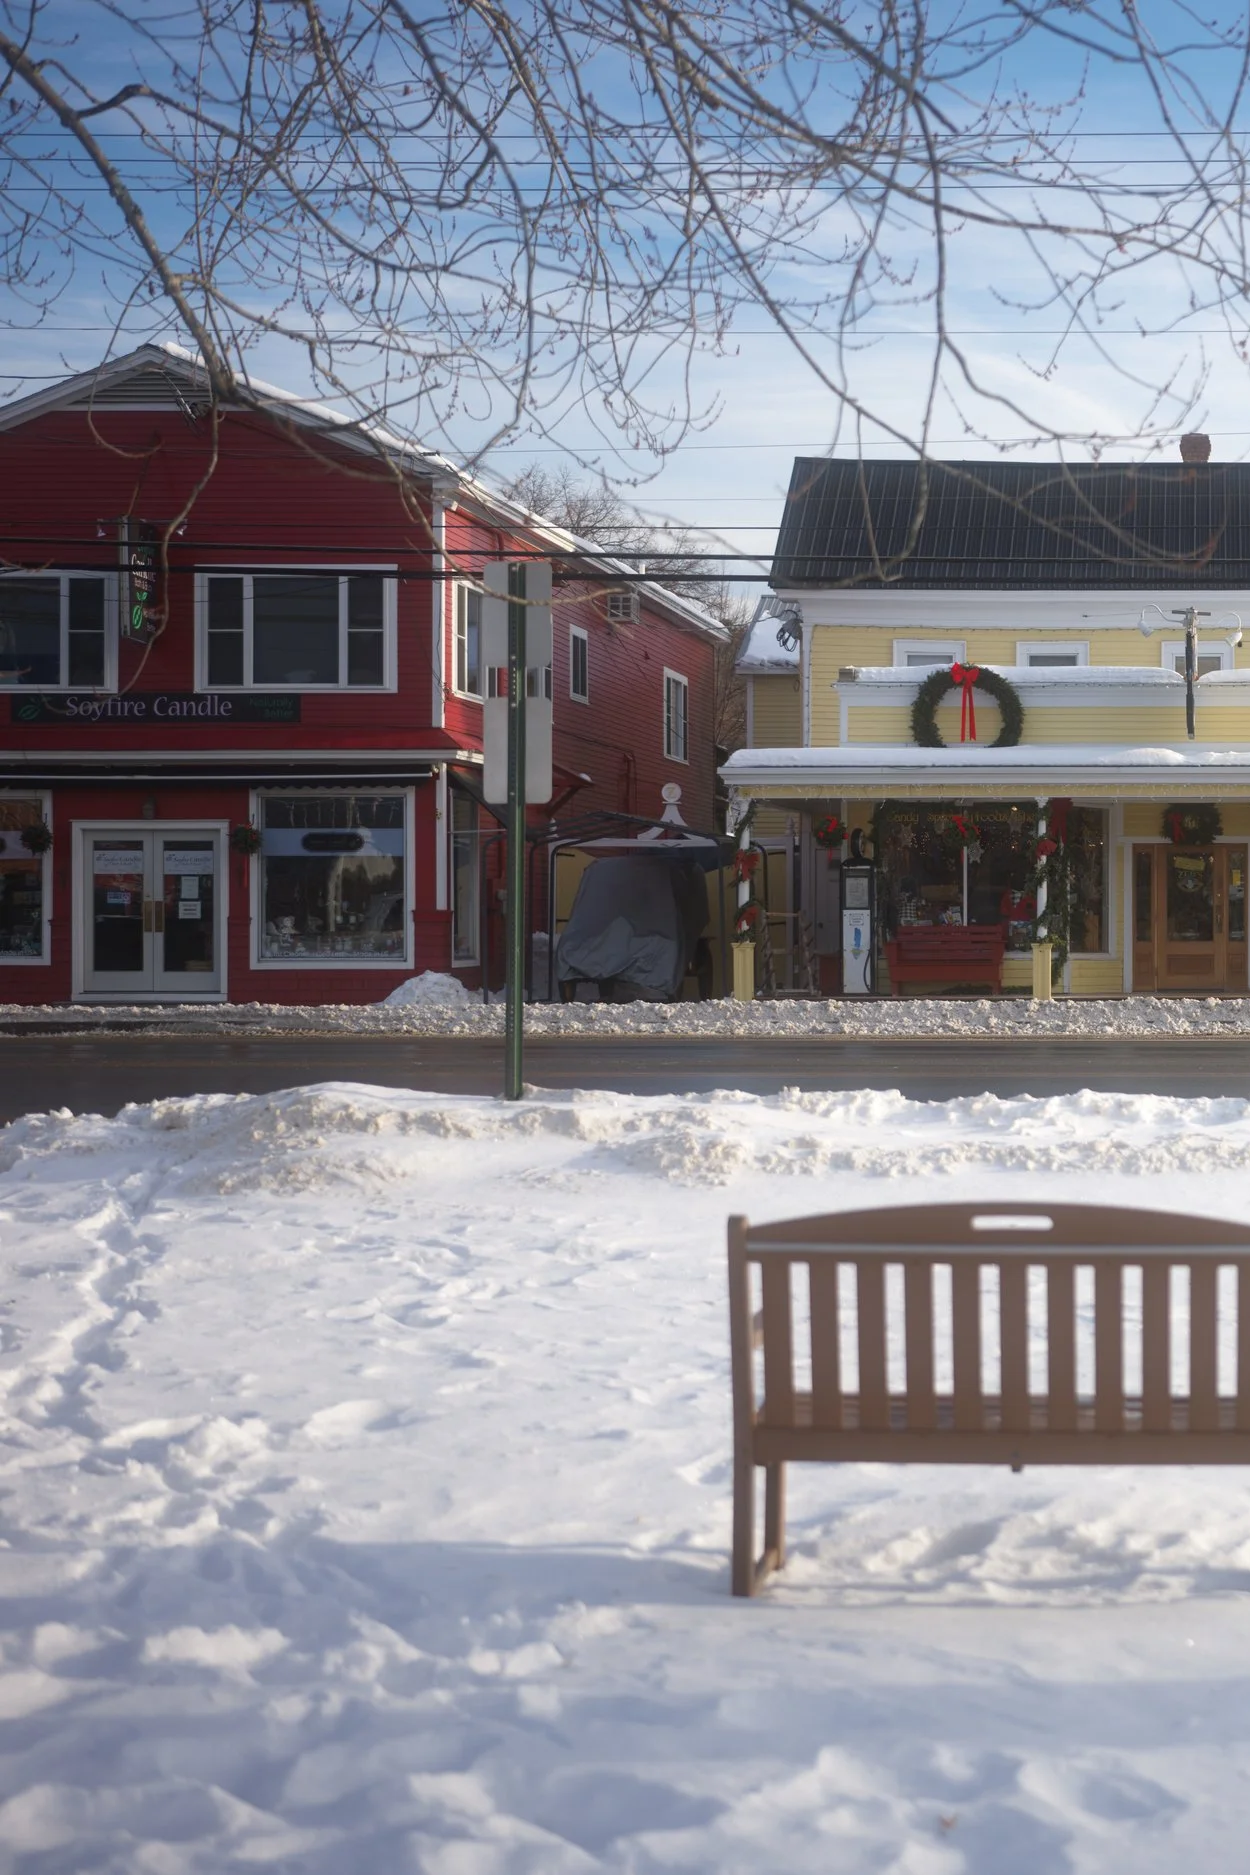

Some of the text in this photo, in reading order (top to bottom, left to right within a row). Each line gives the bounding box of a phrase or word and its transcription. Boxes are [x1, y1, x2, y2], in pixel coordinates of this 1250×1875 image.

[66, 695, 232, 721] Soyfire Candle
[249, 695, 294, 709] Naturally
